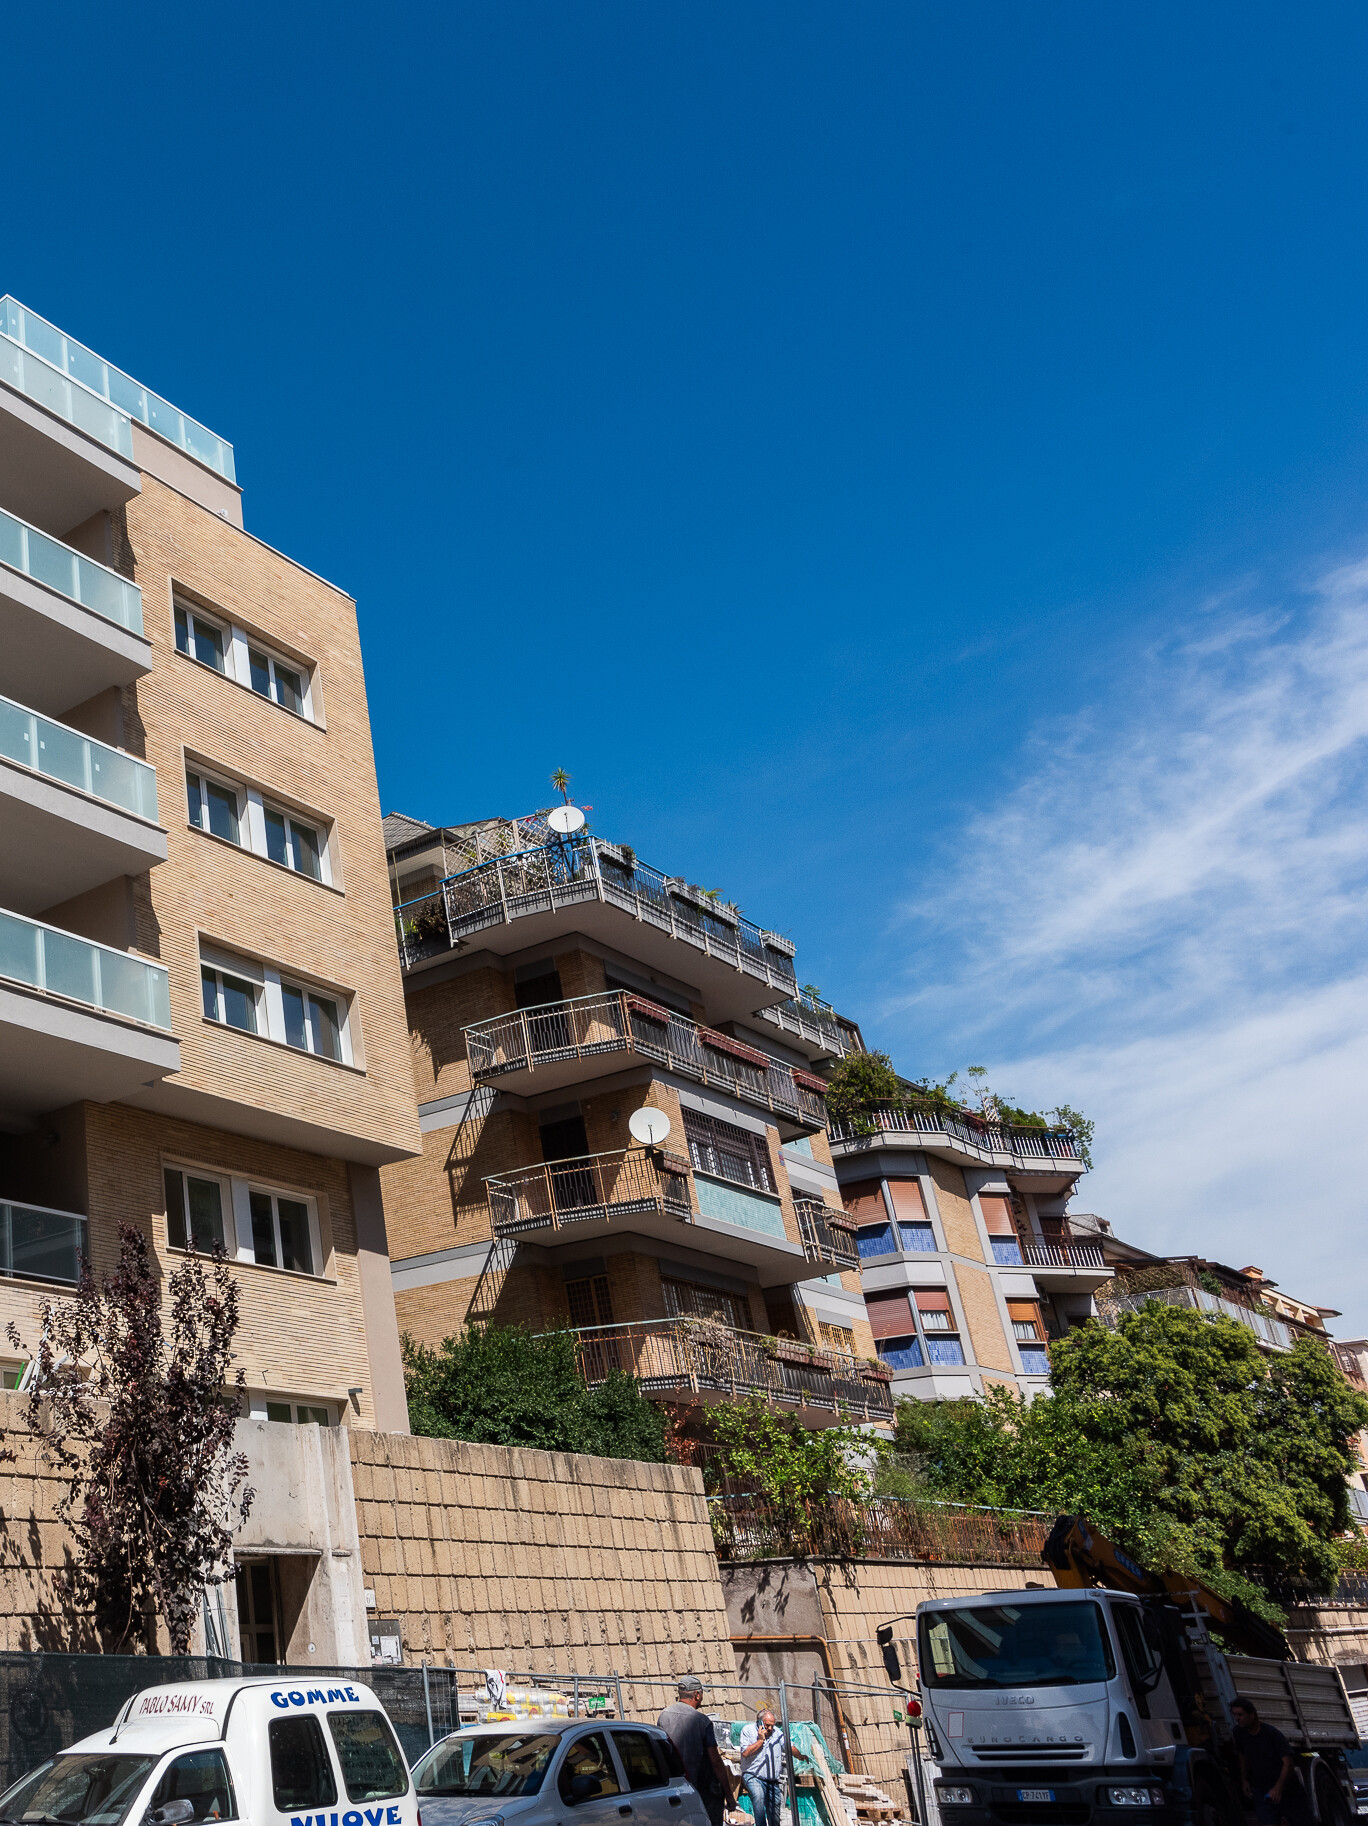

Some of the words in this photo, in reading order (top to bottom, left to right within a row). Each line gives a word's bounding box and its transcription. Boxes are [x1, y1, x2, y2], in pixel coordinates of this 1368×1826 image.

[139, 1695, 169, 1715] PABLO
[167, 1694, 202, 1713] SAMY
[199, 1701, 214, 1715] SRL
[271, 1686, 360, 1709] GOMME
[995, 1695, 1035, 1706] IVECO
[967, 1735, 1083, 1744] EUROCARGO
